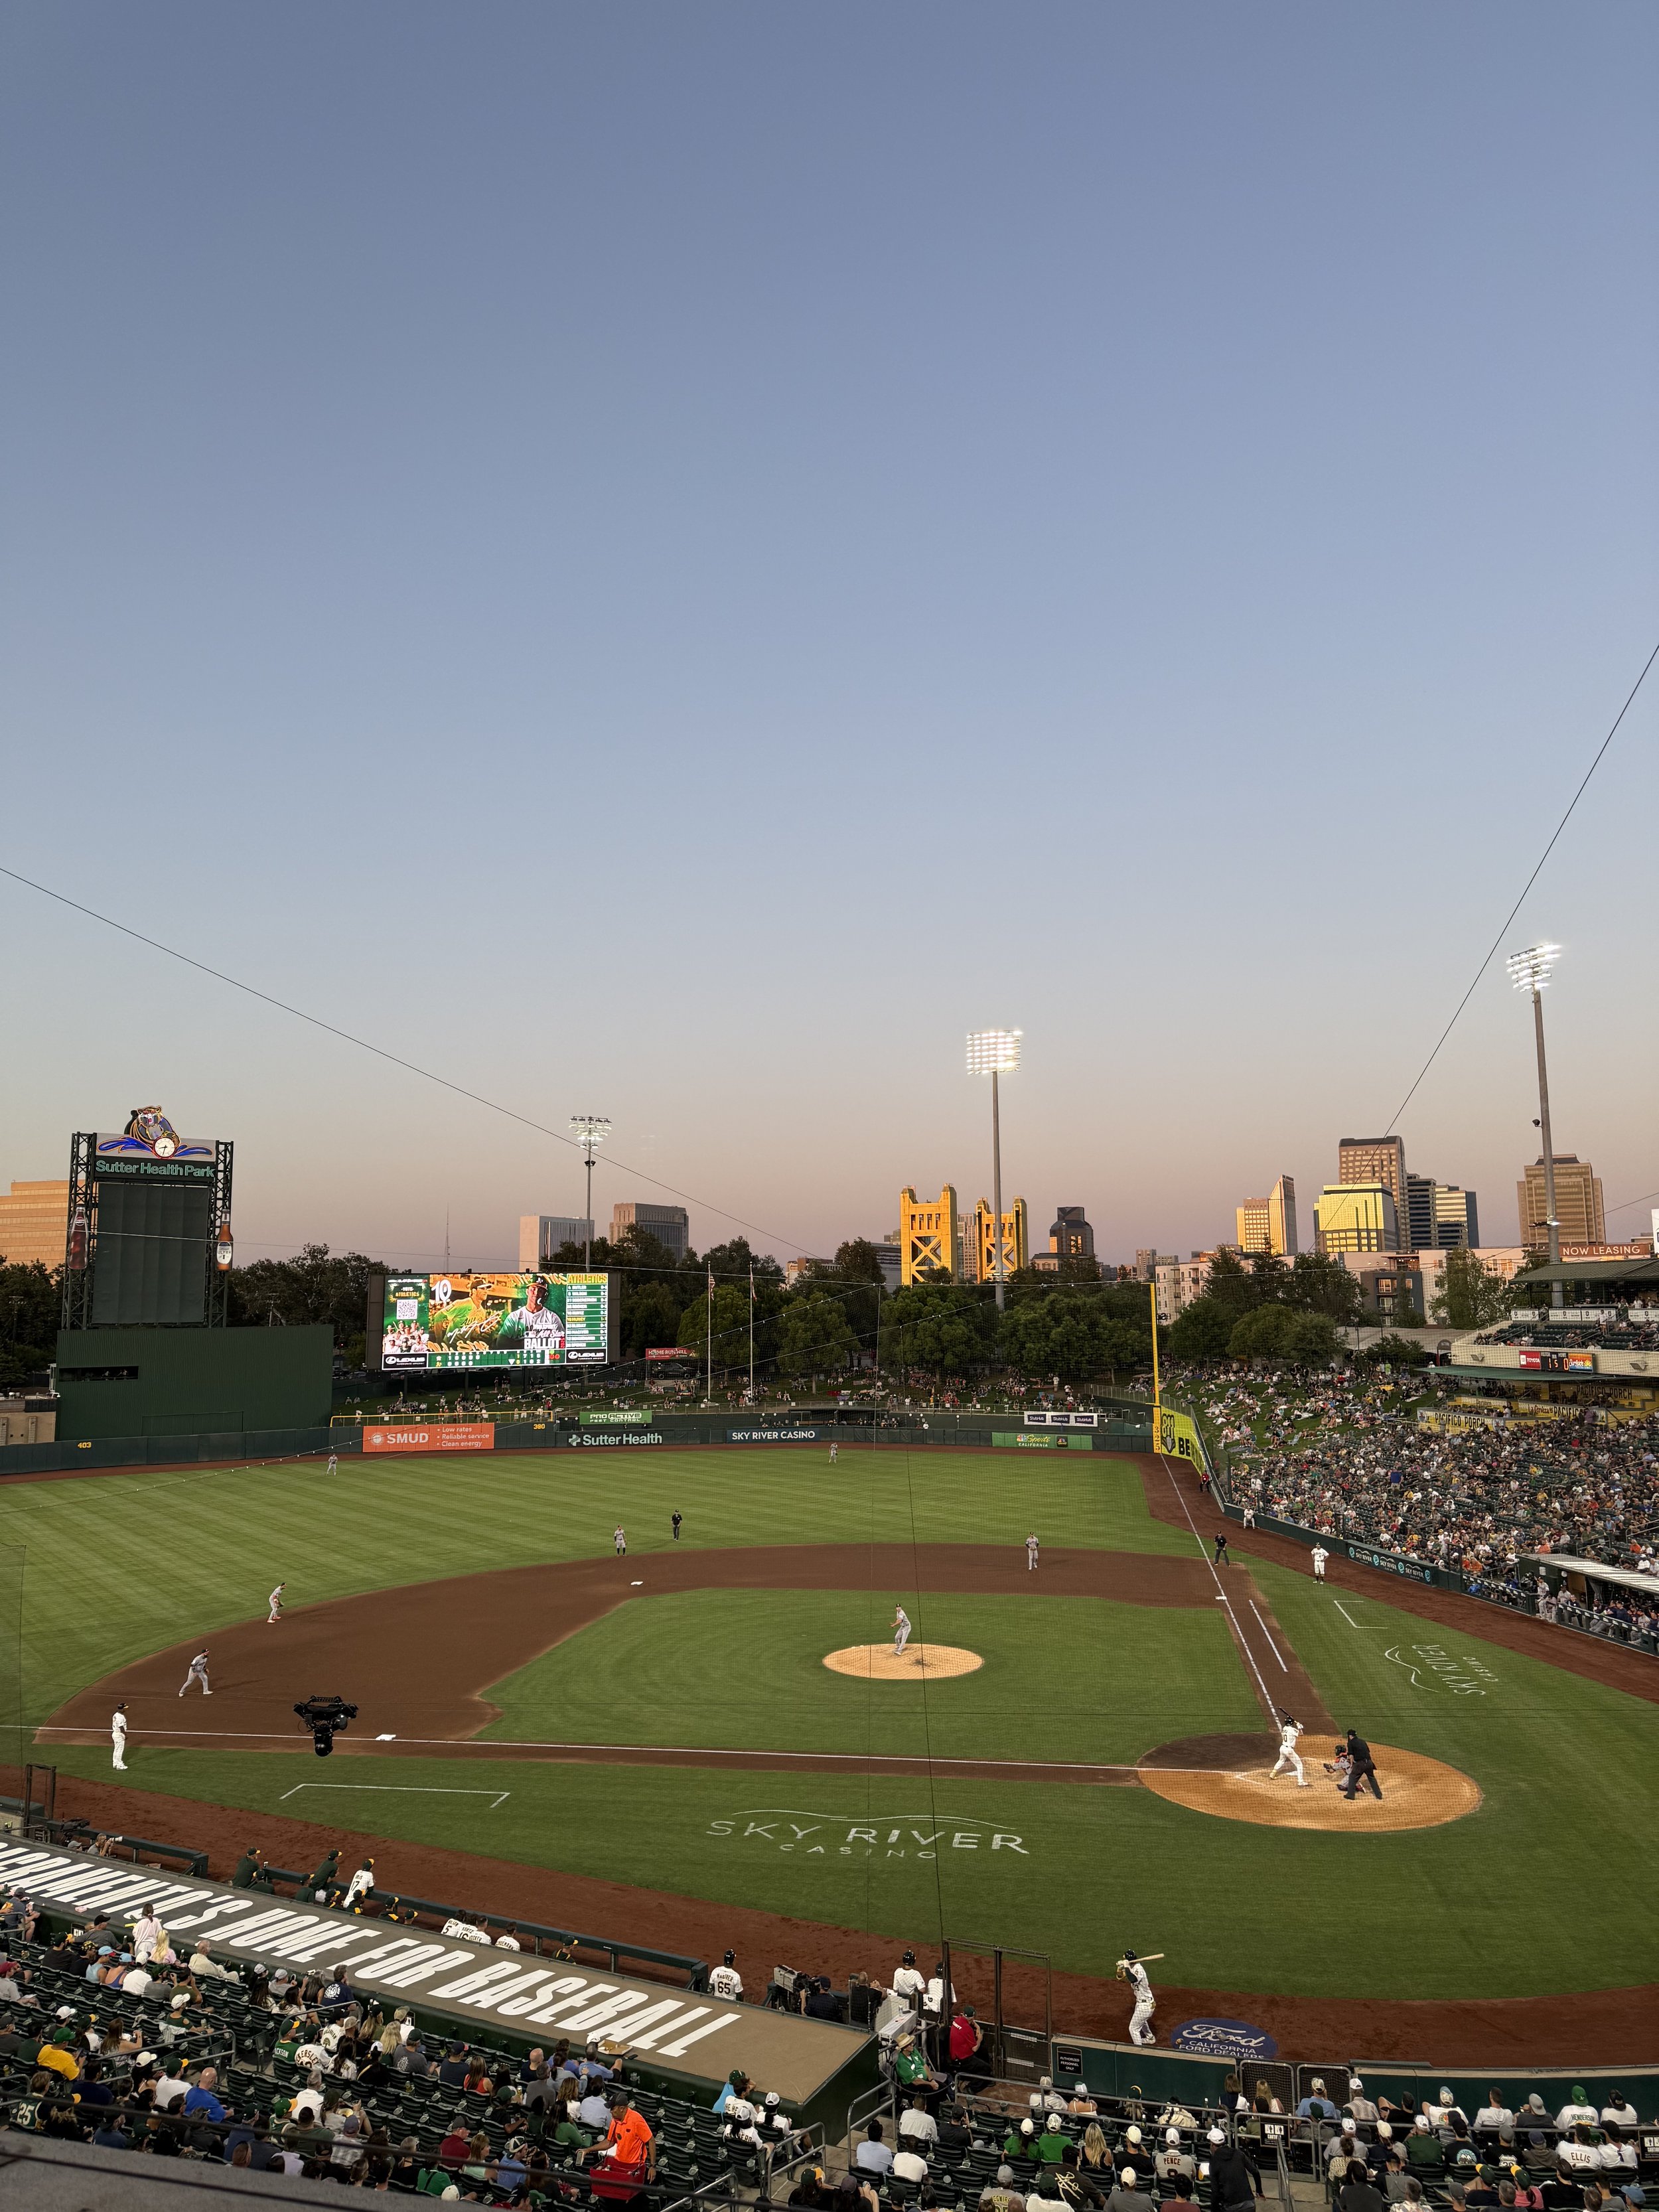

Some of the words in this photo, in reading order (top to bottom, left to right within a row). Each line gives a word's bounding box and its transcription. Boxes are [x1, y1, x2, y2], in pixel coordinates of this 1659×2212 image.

[96, 1160, 139, 1173] Sutter
[140, 1163, 183, 1176] Health
[184, 1165, 216, 1177] Park
[1563, 1247, 1589, 1256] NOW
[1593, 1246, 1640, 1255] LEASING
[567, 1274, 607, 1284] ATHLETICS
[431, 1279, 452, 1303] 10
[524, 1338, 561, 1349] BALLOT
[1563, 1358, 1569, 1370] 0
[1609, 1386, 1632, 1400] PORCH
[1553, 1406, 1585, 1418] PACIFIC
[1435, 1413, 1461, 1426] PACIFICO
[1465, 1416, 1486, 1429] PORCH
[387, 1433, 429, 1445] SMUD
[583, 1434, 622, 1445] Sutter
[622, 1433, 662, 1445] Health
[1362, 1554, 1372, 1562] RIVER
[1412, 1569, 1423, 1578] RIVER
[1411, 1645, 1463, 1671] RIVER
[1462, 1657, 1498, 1682] CASINO
[1438, 1674, 1486, 1695] SKY
[708, 1821, 822, 1840] SKY
[845, 1827, 1030, 1854] RIVER
[778, 1844, 937, 1859] CASINO
[443, 1925, 453, 1934] 5
[0, 1842, 253, 1931] CRAMENTO'S
[198, 1908, 383, 1962] HOME
[326, 1937, 476, 1988] FOR
[425, 1960, 743, 2057] BASEBALL
[717, 1981, 731, 1994] 65
[1183, 2024, 1265, 2047] Ford
[1179, 2045, 1211, 2053] FORD
[1214, 2049, 1265, 2059] DEALERS
[1189, 2041, 1256, 2054] CALIFORNIA
[17, 2102, 35, 2125] 25
[1571, 2114, 1595, 2122] HENDERSON
[1163, 2157, 1181, 2166] PENCE
[1570, 2152, 1591, 2164] ELLIS
